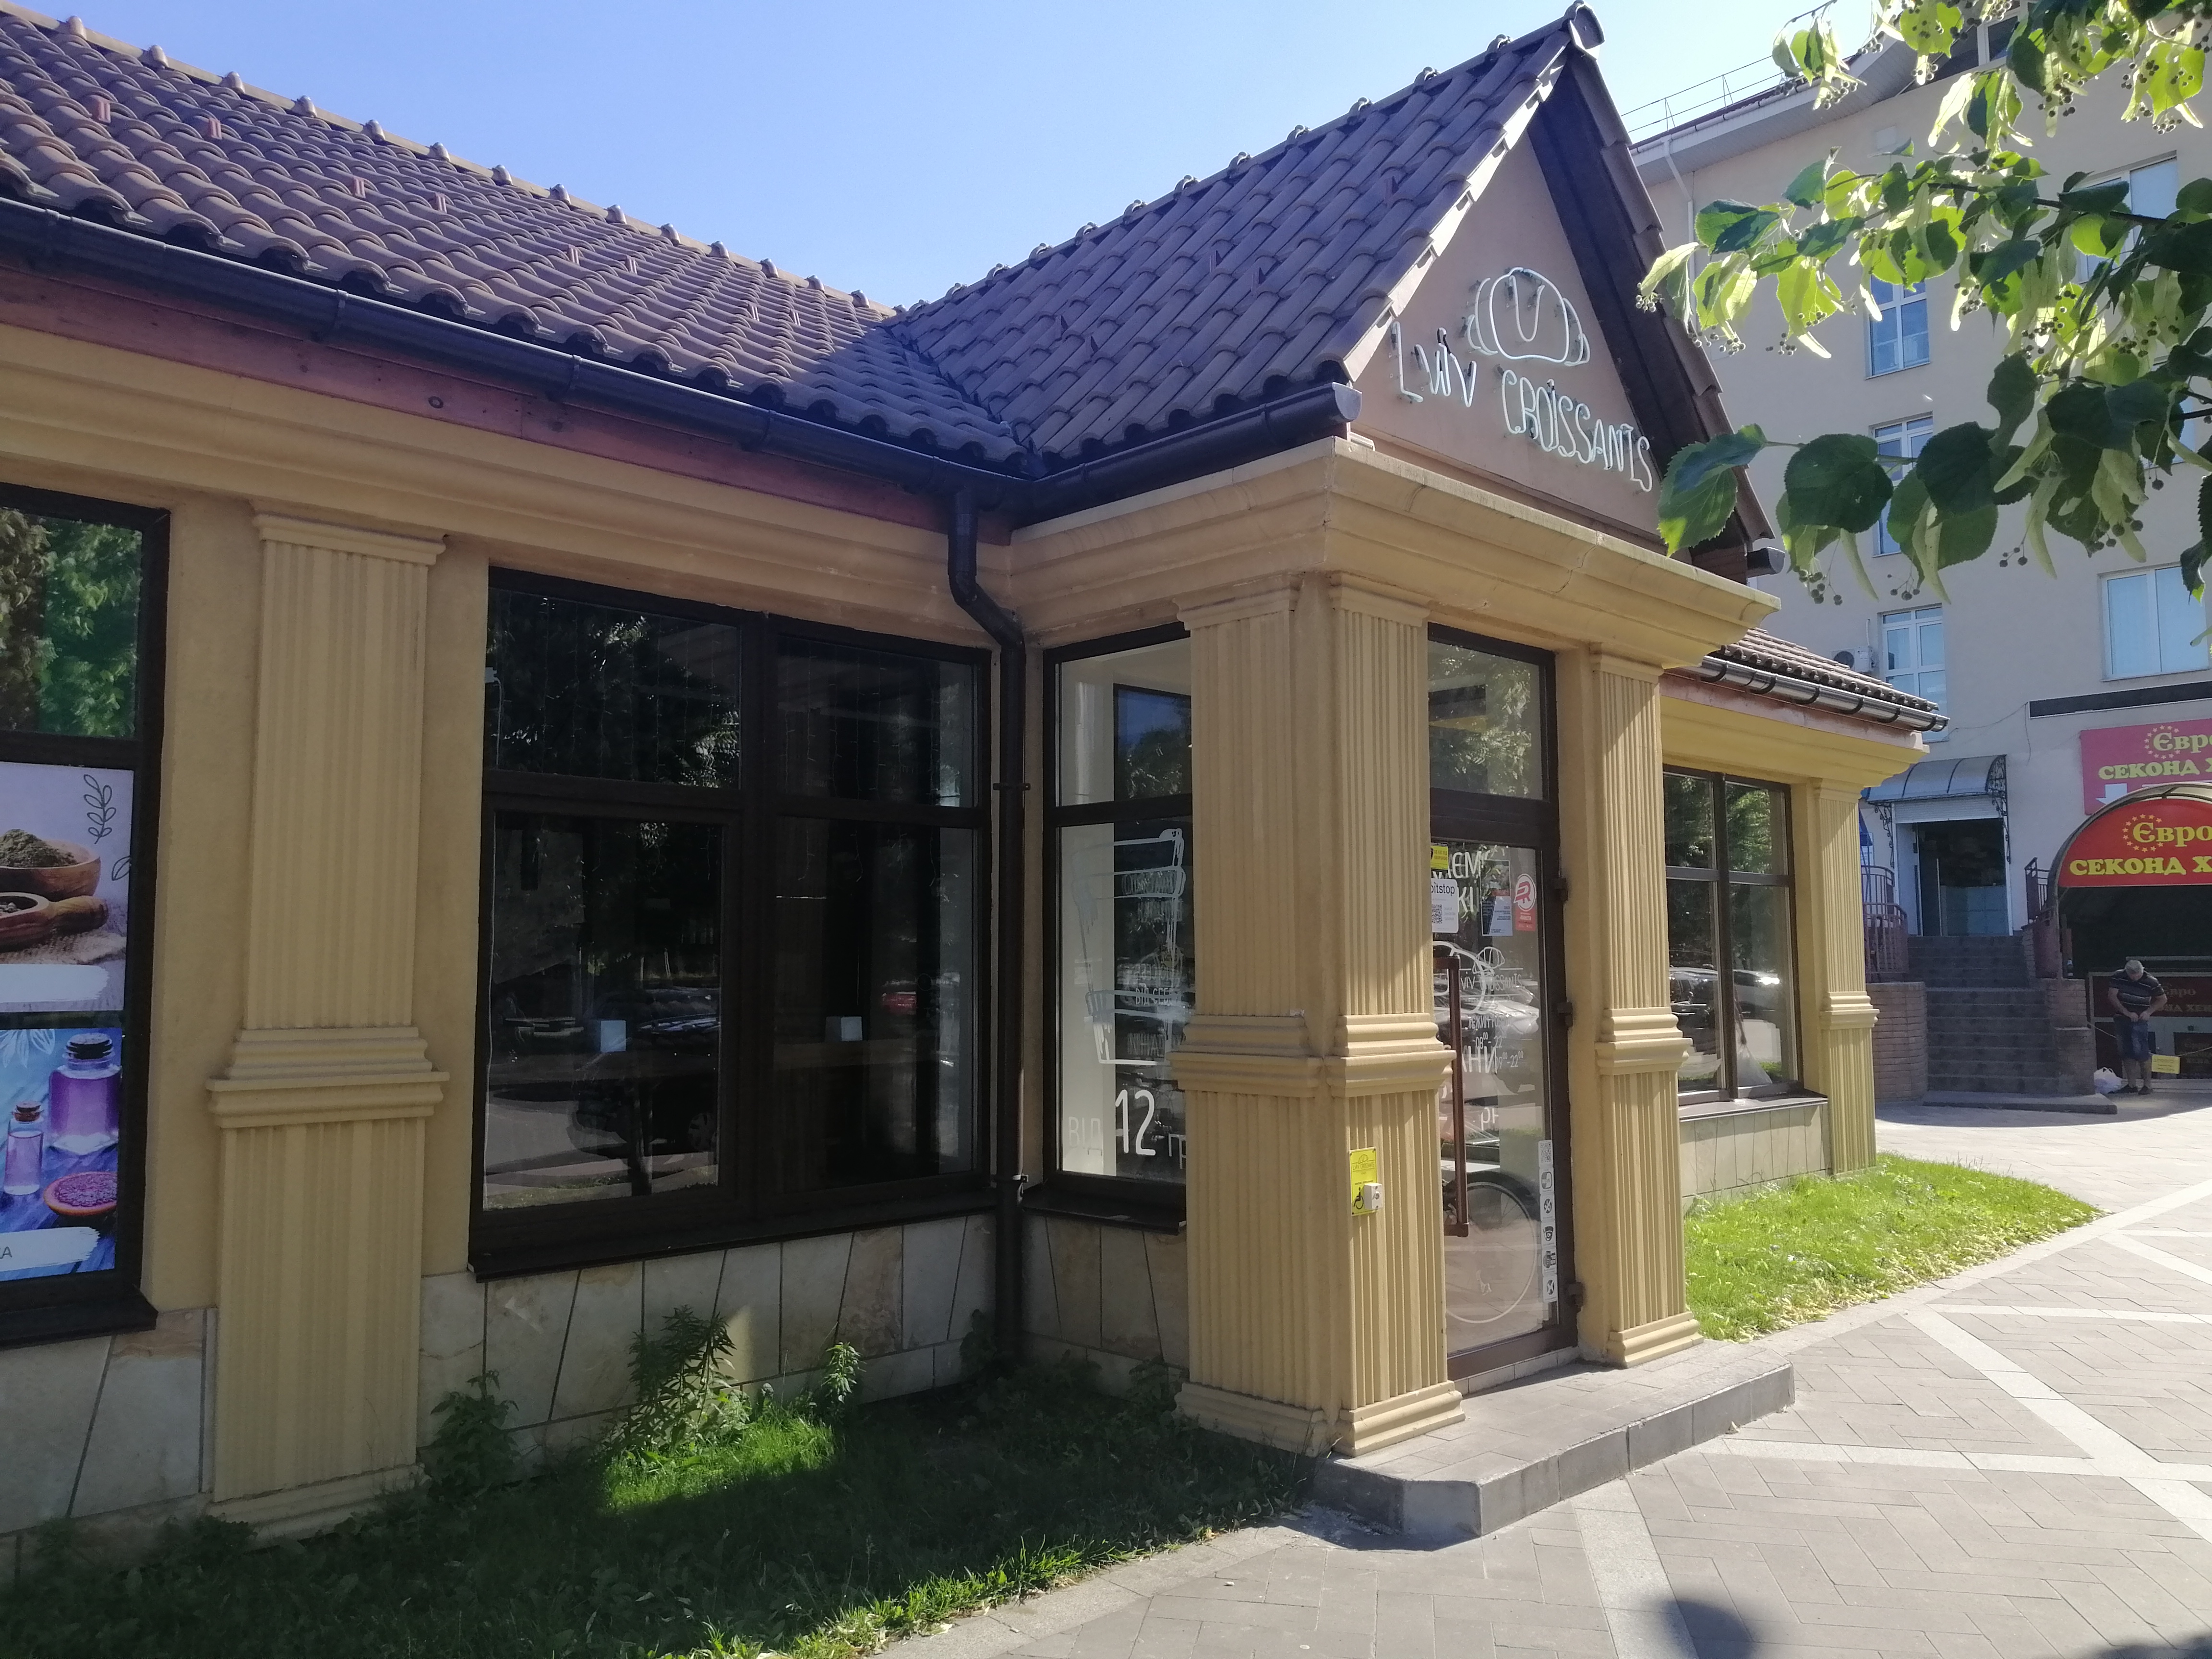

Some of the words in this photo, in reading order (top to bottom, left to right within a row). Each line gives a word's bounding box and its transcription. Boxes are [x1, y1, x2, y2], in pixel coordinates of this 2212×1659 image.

[1502, 370, 1652, 492] CROISSANTS
[2153, 732, 2212, 754] Євр
[2098, 759, 2200, 780] СЕКОНД
[2133, 822, 2212, 847] Євро
[2069, 856, 2187, 876] СЕКОНД
[1115, 1089, 1156, 1156] 12
